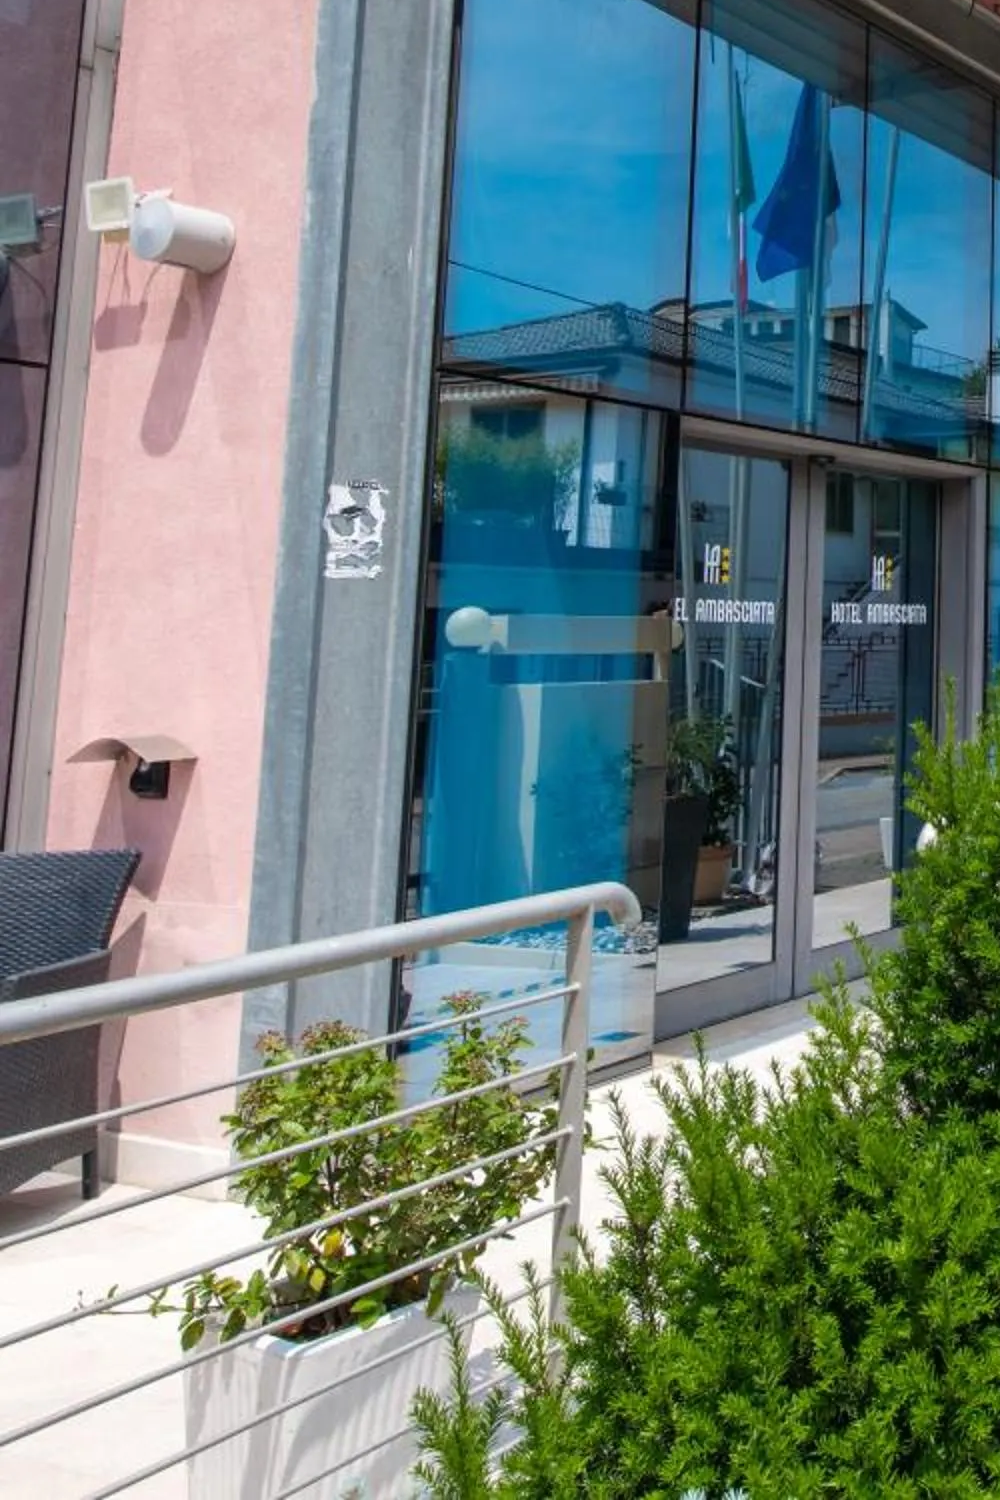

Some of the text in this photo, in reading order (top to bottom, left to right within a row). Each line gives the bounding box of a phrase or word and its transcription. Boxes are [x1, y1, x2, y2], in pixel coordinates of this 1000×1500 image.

[695, 598, 775, 625] AMBASCIATA
[831, 602, 927, 625] HOTEL AMBASCIATA
